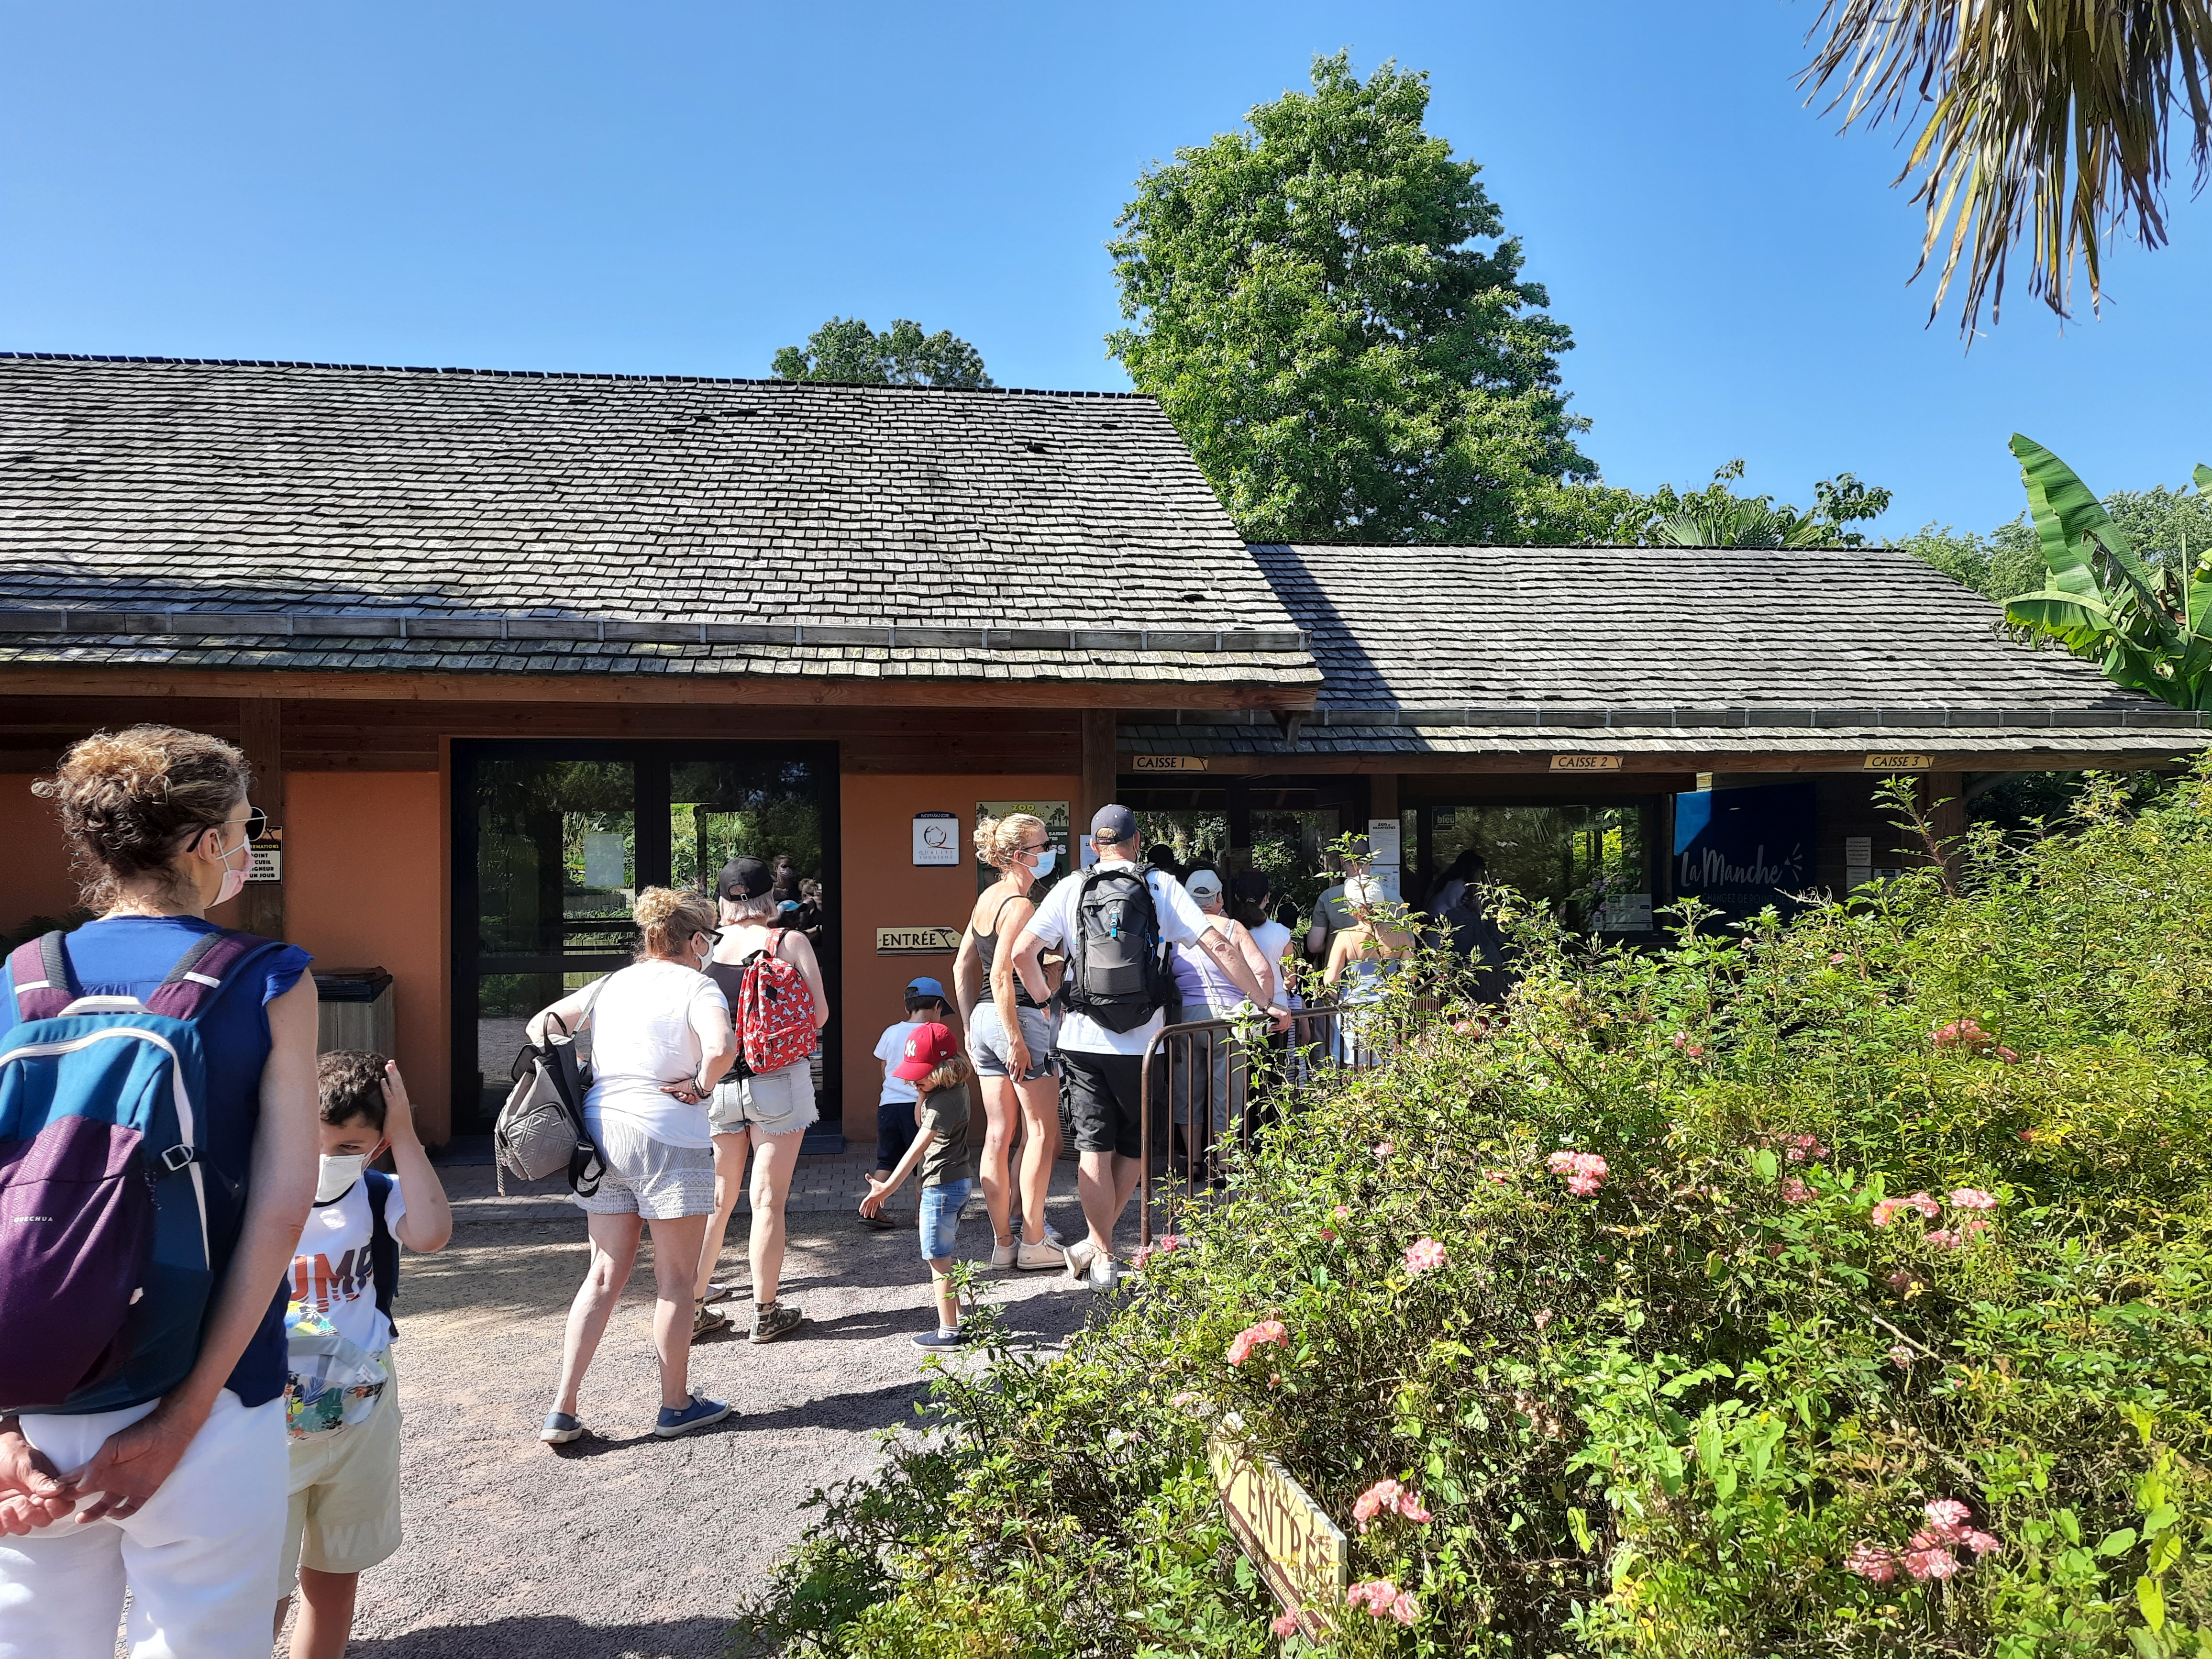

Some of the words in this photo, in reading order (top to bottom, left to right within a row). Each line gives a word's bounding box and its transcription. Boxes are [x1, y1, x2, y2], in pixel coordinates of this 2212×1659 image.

[1137, 757, 1177, 768] CAISSE
[1181, 757, 1185, 768] 1
[1558, 757, 1597, 767] CAISSE
[1600, 757, 1608, 767] 2
[1872, 756, 1910, 767] CAISSE
[1912, 756, 1920, 766] 3
[1011, 804, 1035, 812] ZOO
[1437, 815, 1455, 823] bleu
[1681, 851, 1702, 887] La
[1703, 844, 1782, 888] Manche
[1702, 892, 1736, 903] CHANGEZ
[1738, 894, 1748, 903] DE
[1749, 894, 1773, 904] POINT
[1775, 895, 1785, 905] DE
[883, 931, 937, 946] ENTRÉE
